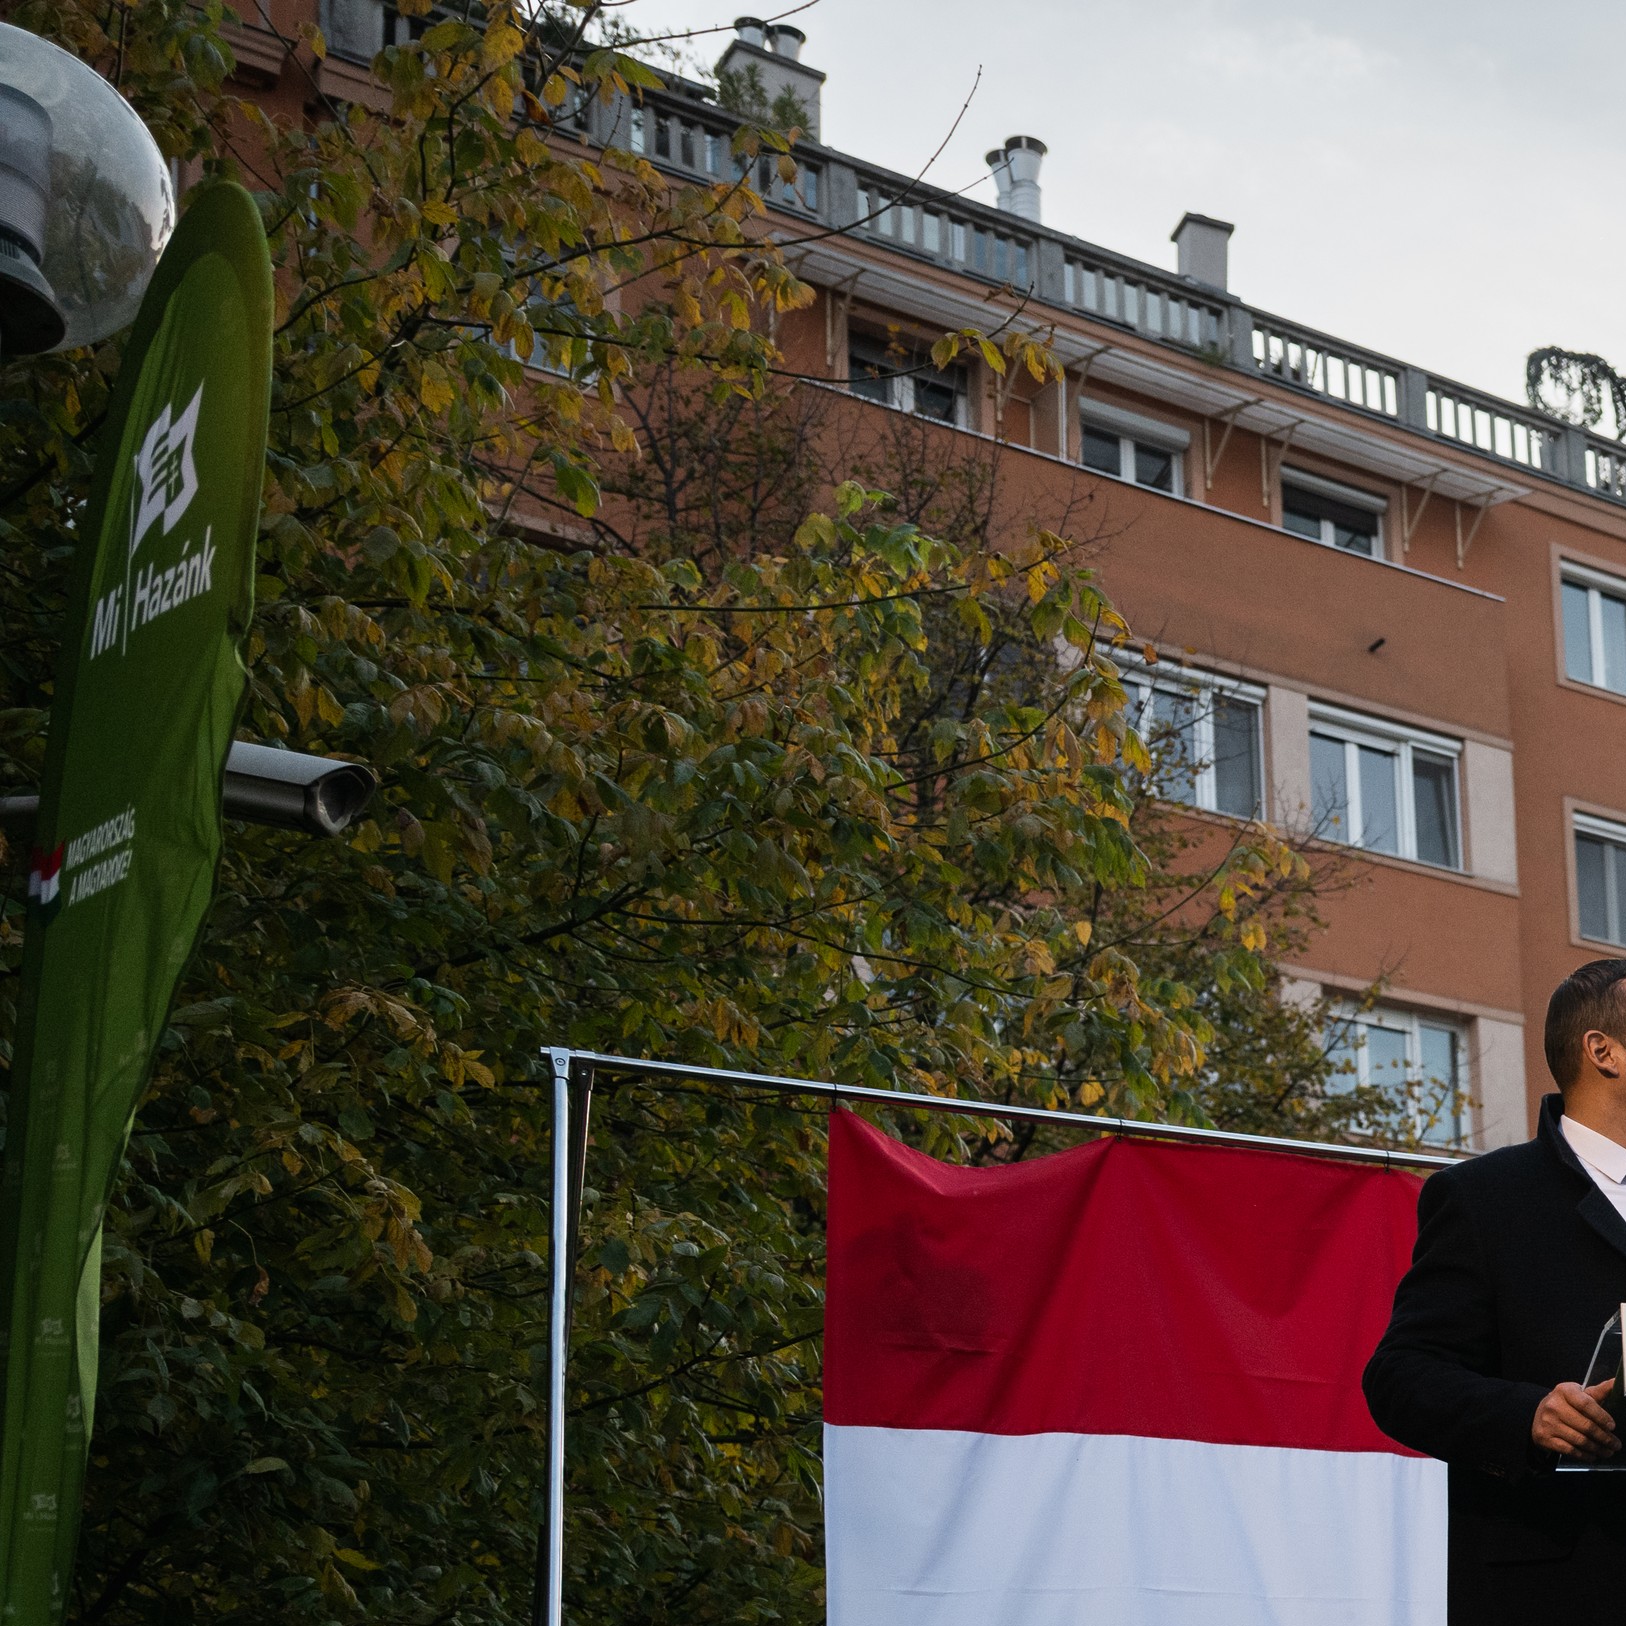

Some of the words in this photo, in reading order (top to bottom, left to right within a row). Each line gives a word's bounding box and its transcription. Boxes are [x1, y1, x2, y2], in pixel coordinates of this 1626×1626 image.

[90, 583, 123, 661] Mi
[131, 524, 217, 632] Hazánk
[65, 800, 136, 872] MAGYARORSZÁG
